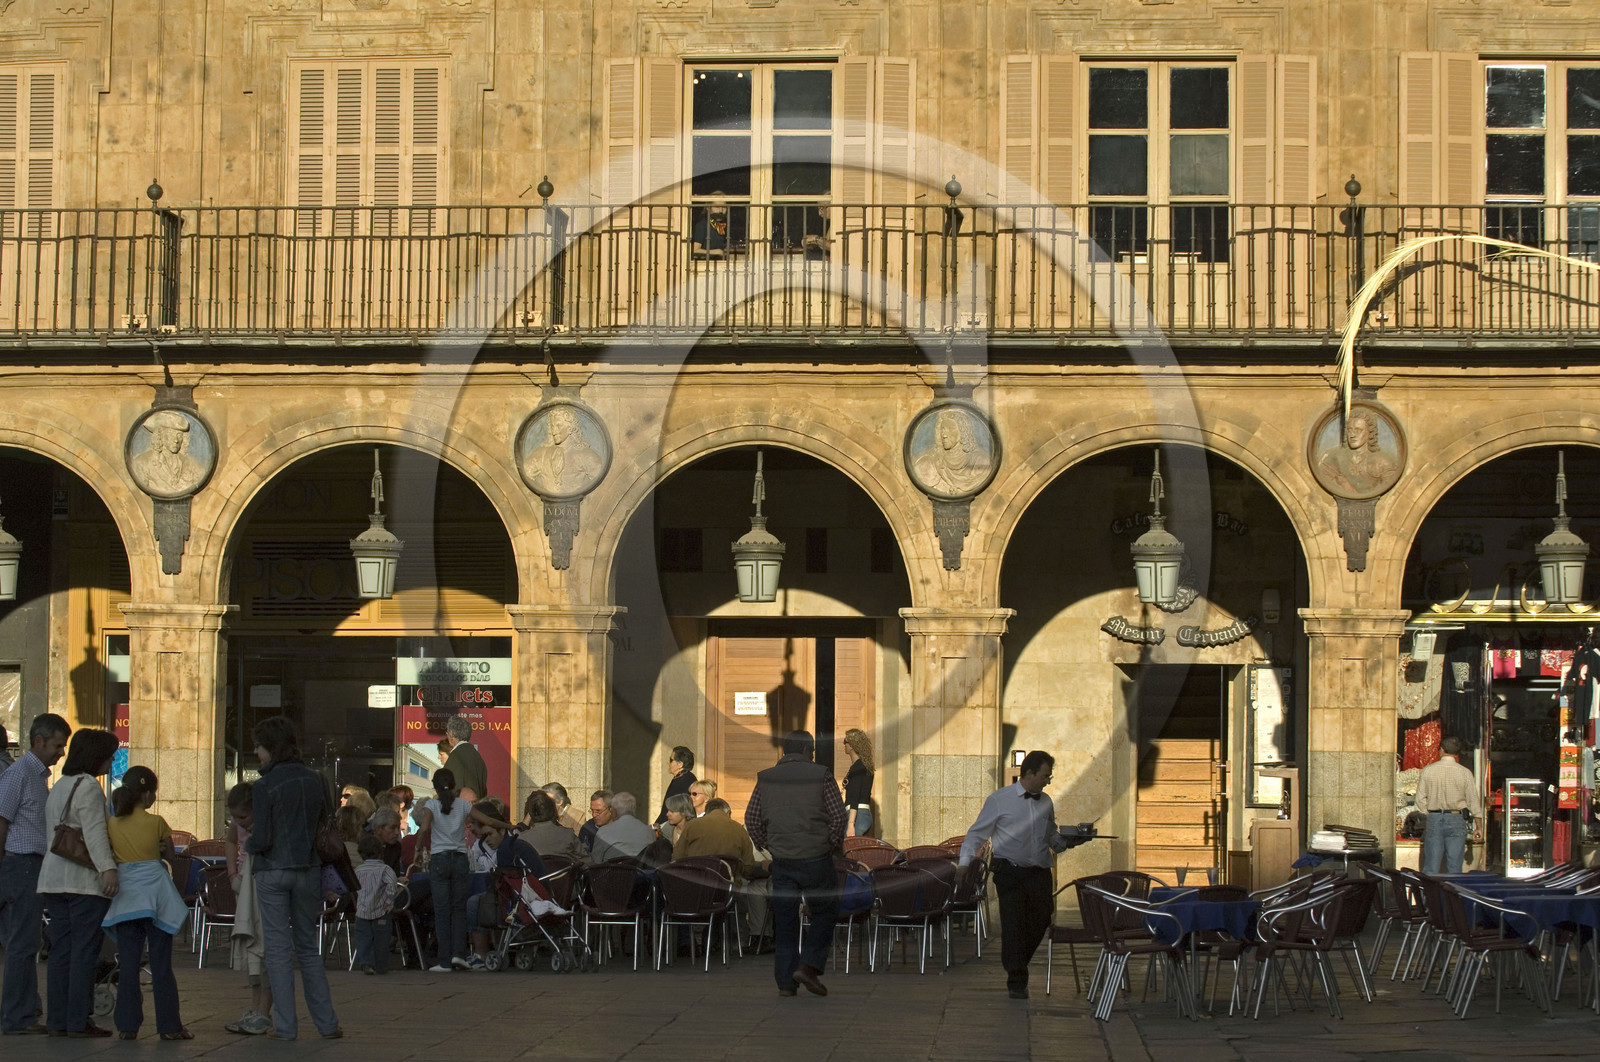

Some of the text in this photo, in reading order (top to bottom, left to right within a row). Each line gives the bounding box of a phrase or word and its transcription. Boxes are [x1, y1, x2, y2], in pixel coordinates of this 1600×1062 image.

[234, 557, 359, 601] PISO
[1179, 616, 1257, 643] Cervantes
[419, 661, 491, 674] ABIERTO
[420, 674, 449, 682] TODOS
[451, 674, 468, 682] LOS
[416, 686, 494, 703] Chalets
[115, 718, 129, 728] NO
[406, 721, 422, 730] NO
[425, 721, 485, 731] COBOS
